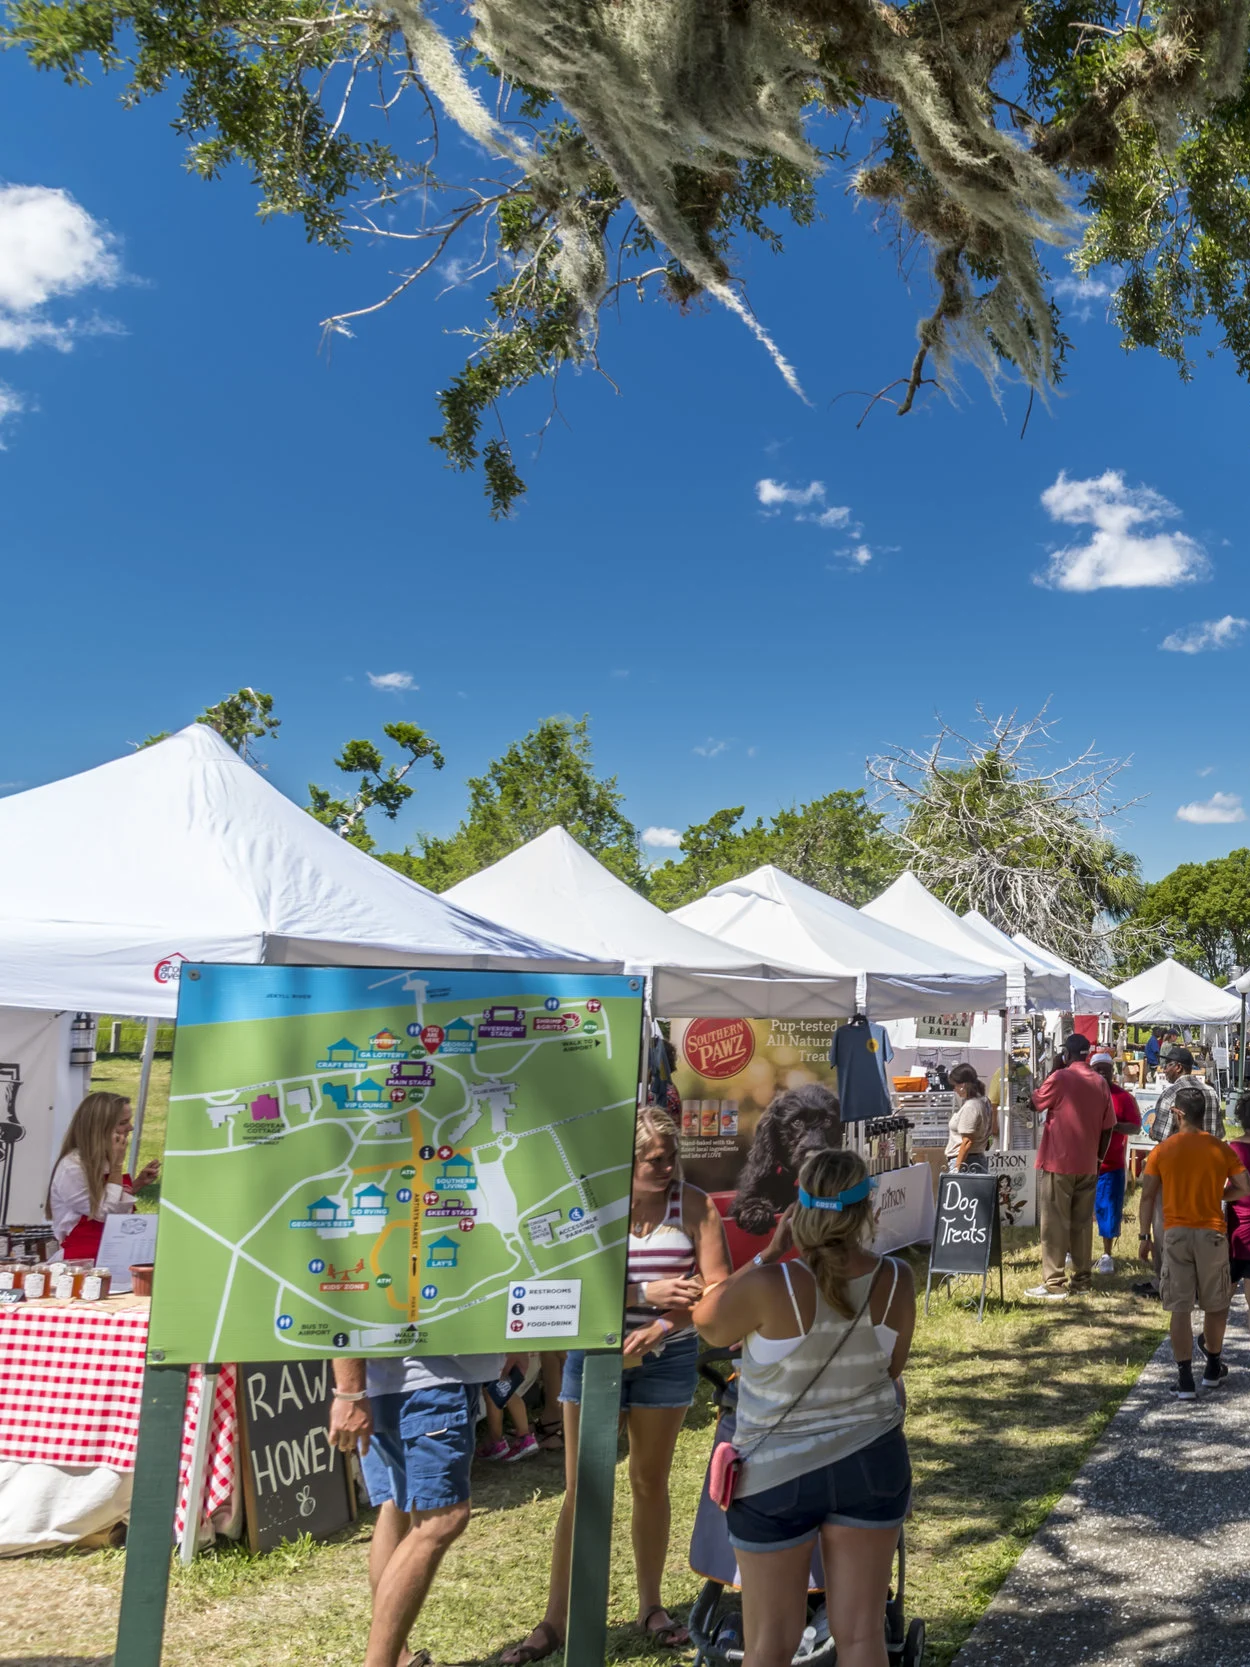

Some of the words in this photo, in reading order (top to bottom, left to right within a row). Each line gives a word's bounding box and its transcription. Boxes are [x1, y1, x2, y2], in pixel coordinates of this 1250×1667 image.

[771, 1019, 838, 1034] Pup-tested
[929, 1026, 957, 1036] BATH
[687, 1021, 744, 1053] SOUTHERN
[766, 1034, 785, 1046] All
[789, 1035, 832, 1046] Natura
[563, 1045, 593, 1053] AIRPORT
[698, 1033, 747, 1070] PAWZ
[816, 1201, 838, 1209] COSTA
[943, 1181, 978, 1221] Dog
[290, 1220, 331, 1228] GEORGIA'S
[559, 1216, 598, 1235] ACCESSIBLE
[565, 1224, 595, 1239] PARKING
[941, 1216, 986, 1246] Treats
[247, 1359, 328, 1421] RAW
[251, 1426, 337, 1496] HONEY
